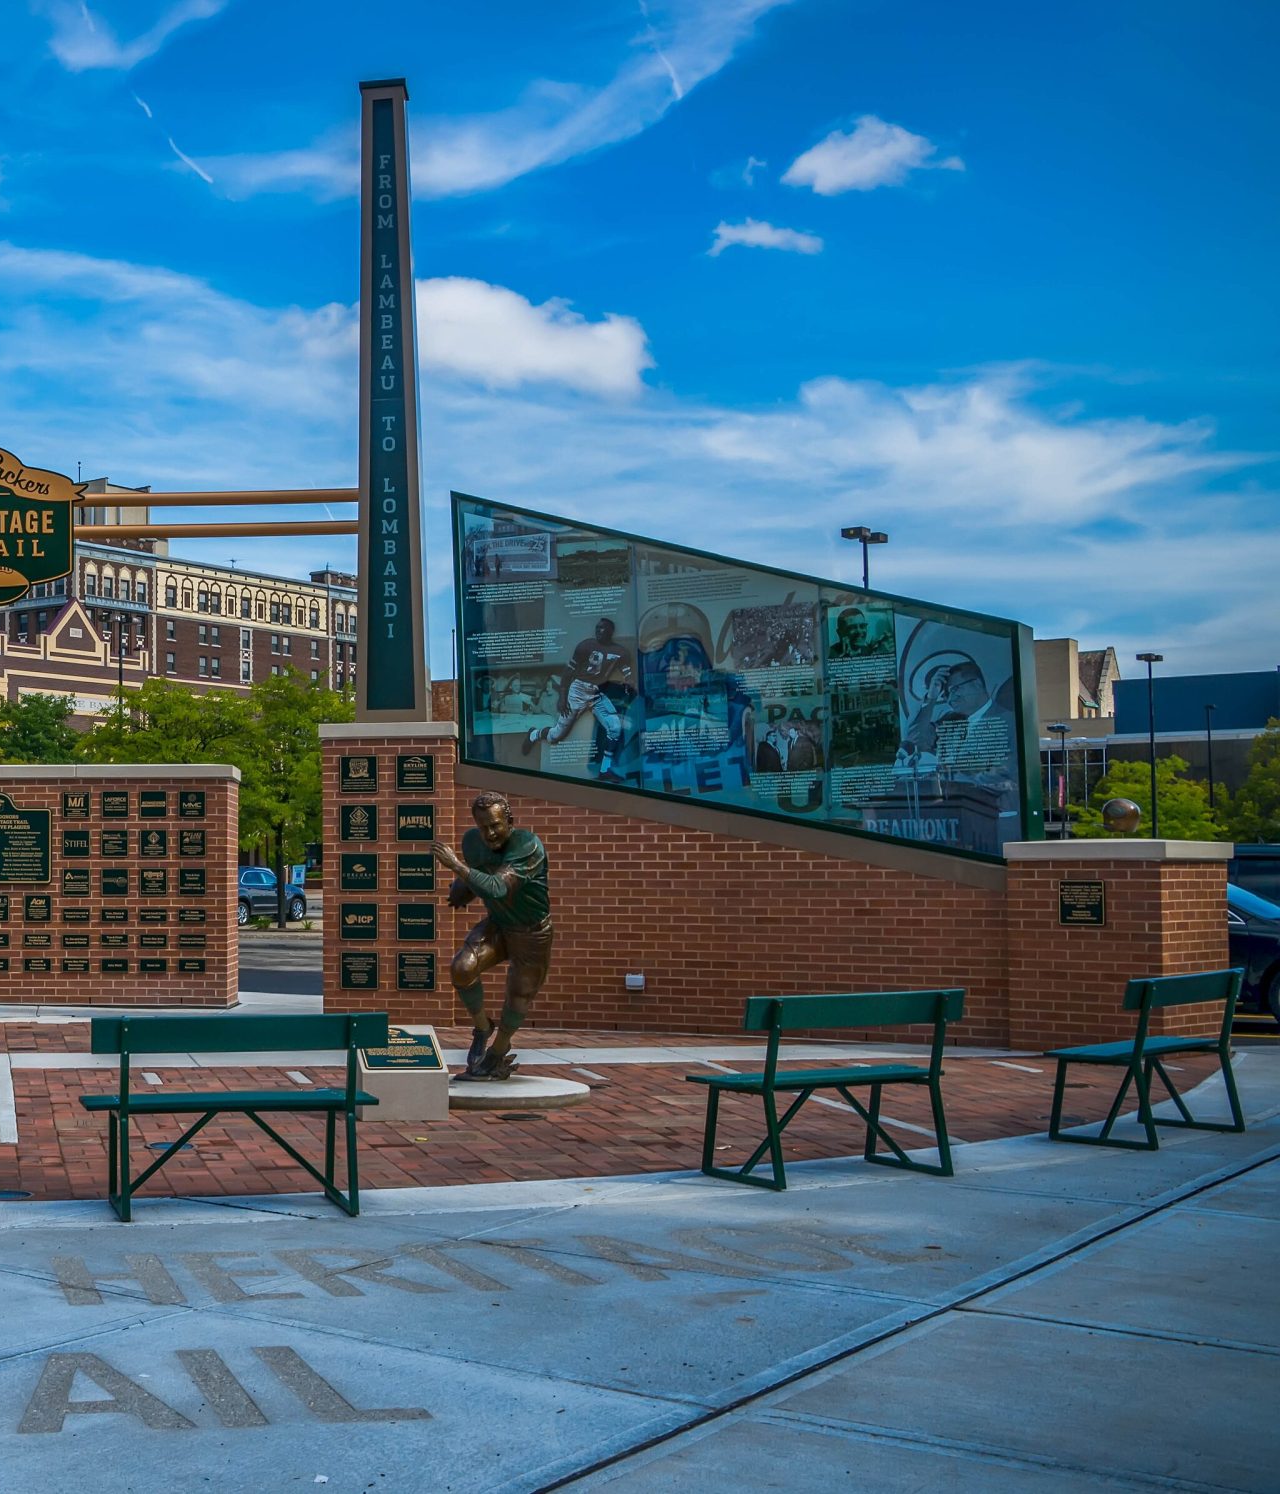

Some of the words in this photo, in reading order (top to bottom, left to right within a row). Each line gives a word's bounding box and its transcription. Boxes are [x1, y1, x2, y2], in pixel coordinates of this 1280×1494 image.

[377, 155, 394, 229] FROM
[378, 254, 395, 391] LAMBEAU
[382, 416, 396, 452] TO
[381, 478, 398, 639] LOMBARDI
[399, 816, 432, 828] MARTELL
[358, 915, 374, 924] ICP
